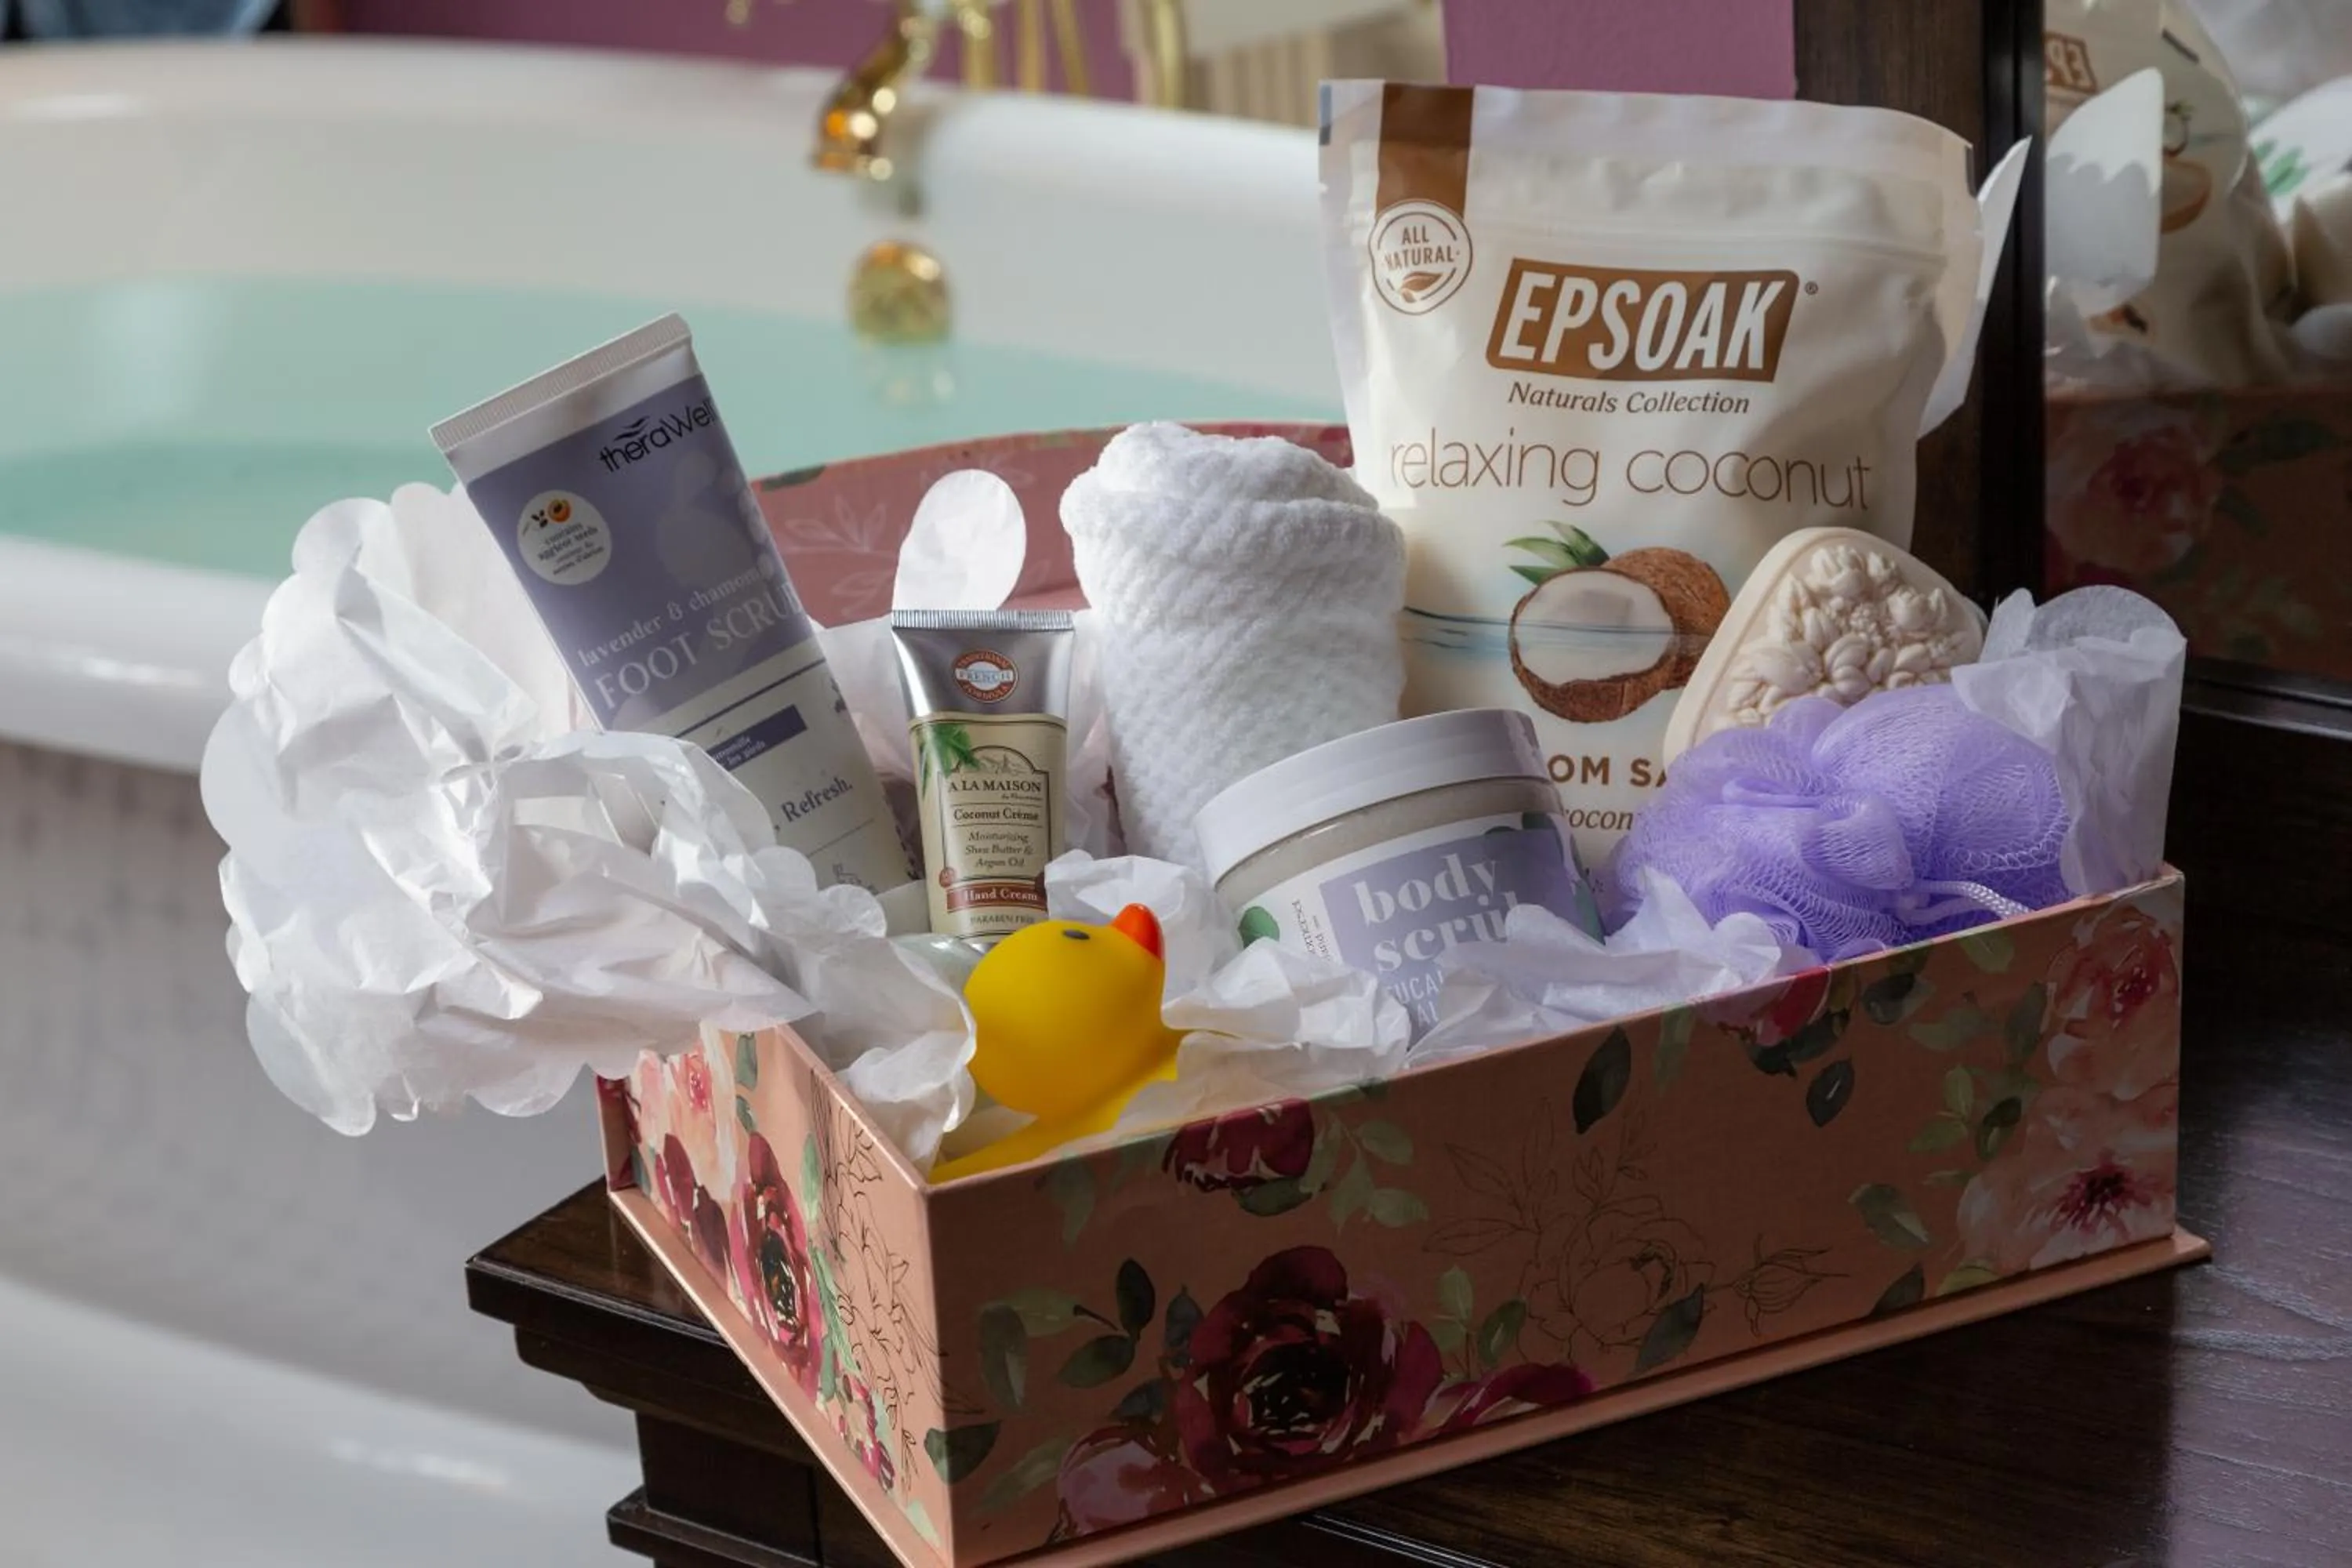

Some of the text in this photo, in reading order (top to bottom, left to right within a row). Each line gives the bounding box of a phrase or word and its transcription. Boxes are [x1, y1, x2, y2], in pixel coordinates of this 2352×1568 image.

[1401, 224, 1429, 245] ALL
[1385, 245, 1454, 271] NATURAL
[1498, 270, 1787, 372] EPSOAK
[1507, 381, 1750, 415] Naturals Collection
[1389, 426, 1871, 510] relaxing coconut
[577, 615, 664, 666] lavender
[594, 631, 699, 710] FOOT
[957, 670, 1011, 682] FRENCH
[780, 776, 853, 823] Refresh.
[962, 780, 980, 792] LA
[982, 780, 1042, 793] MAISON
[953, 808, 1000, 821] Coconut
[964, 845, 989, 855] Shea
[992, 844, 1022, 855] Butter
[1007, 856, 1025, 867] Oil
[965, 887, 1038, 902] Hand Cream
[1352, 852, 1496, 928] body
